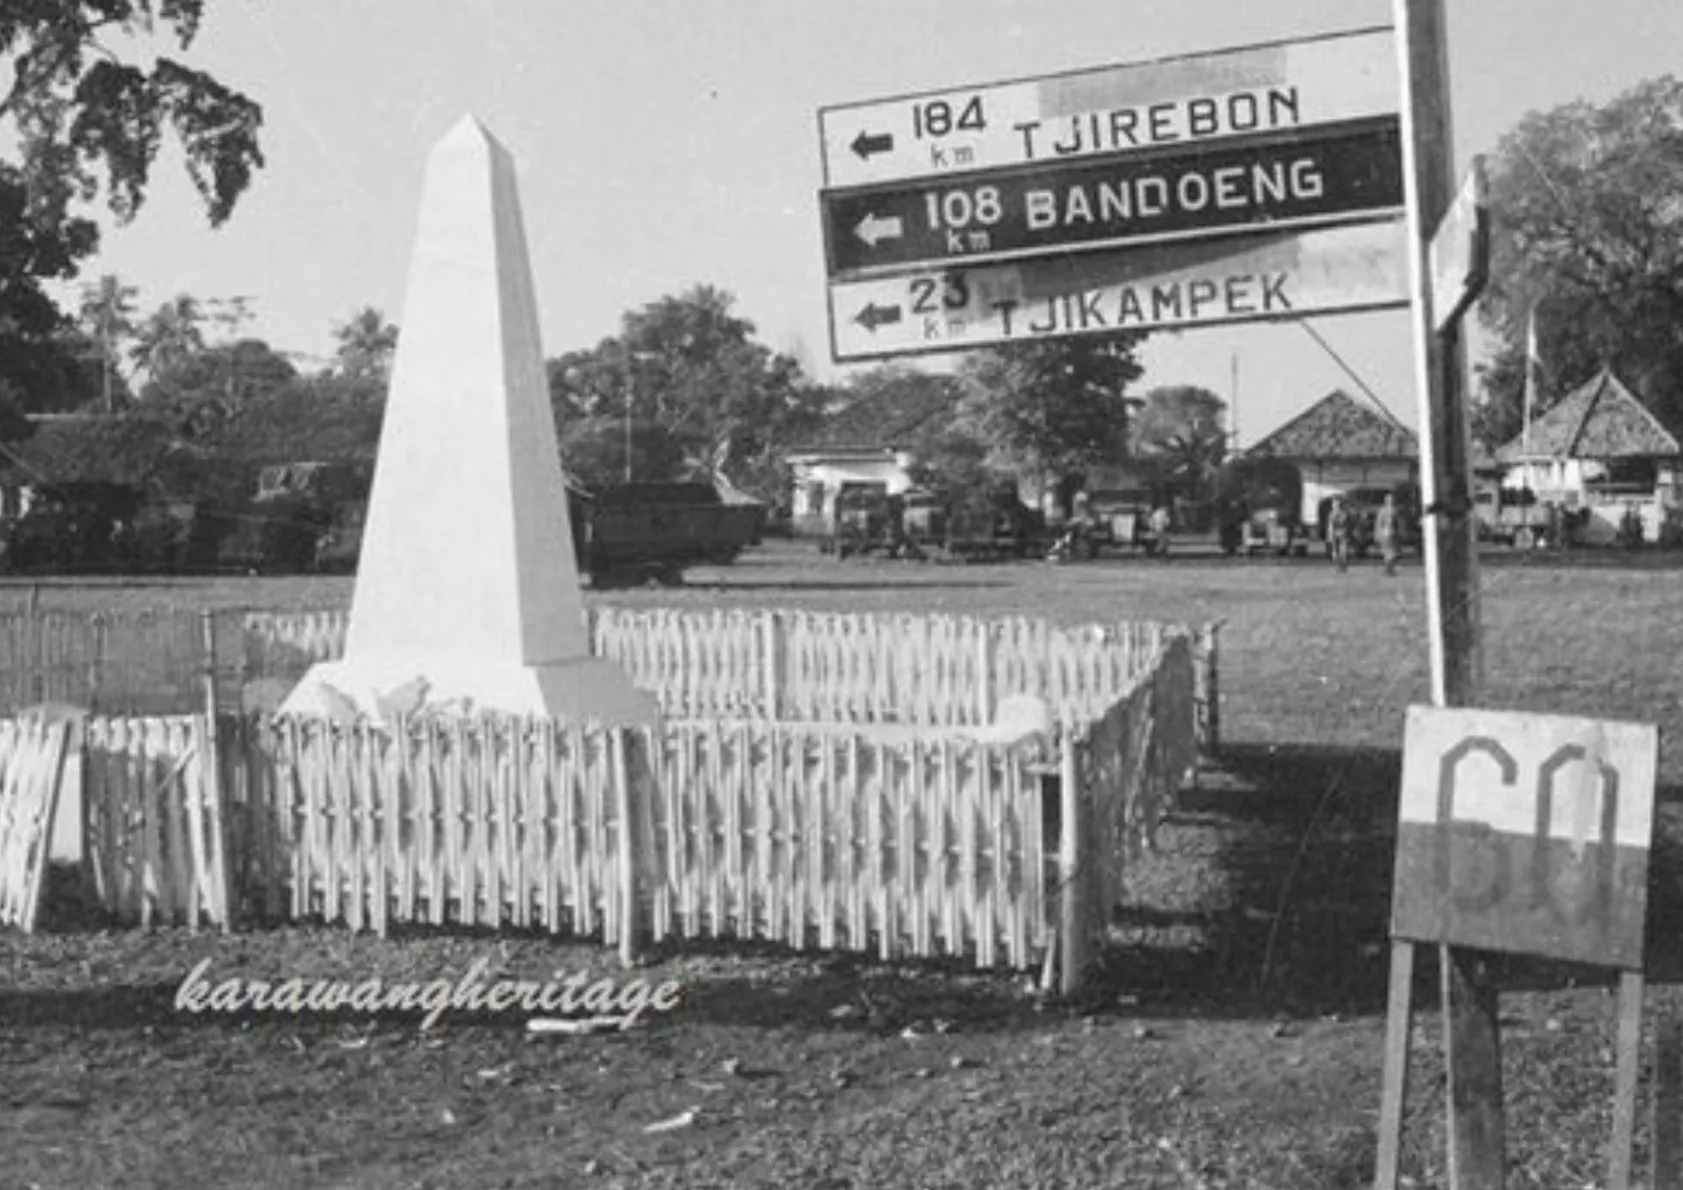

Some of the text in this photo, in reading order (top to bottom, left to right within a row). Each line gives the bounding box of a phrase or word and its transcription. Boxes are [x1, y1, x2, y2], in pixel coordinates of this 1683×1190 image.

[914, 88, 1301, 158] 184 TJIREBON
[932, 144, 974, 166] km
[926, 159, 1323, 230] 108 BANDOENG
[948, 230, 991, 253] km
[910, 272, 1292, 336] 23 TJIKAMPEK
